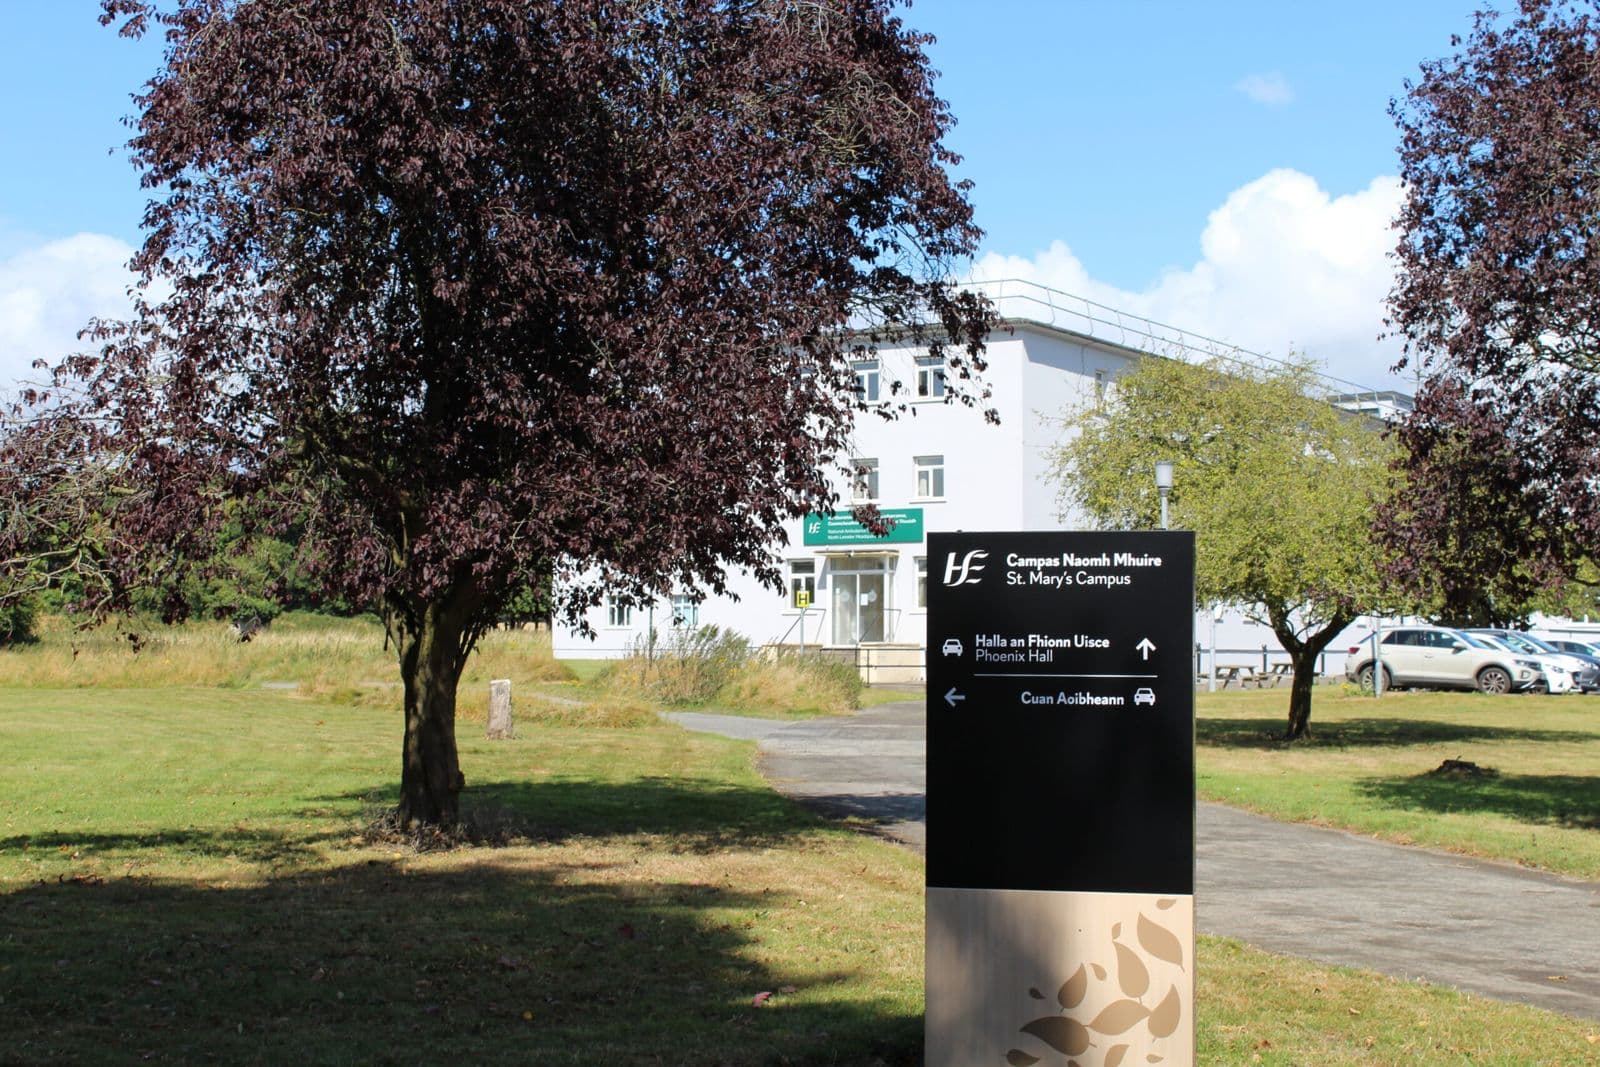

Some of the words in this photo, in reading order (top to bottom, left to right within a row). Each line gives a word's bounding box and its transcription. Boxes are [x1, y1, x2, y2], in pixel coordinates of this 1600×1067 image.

[1007, 553, 1060, 571] Campas
[1063, 553, 1110, 567] Naomh
[1114, 553, 1162, 566] Mhuire
[1007, 571, 1026, 585] St.
[1030, 571, 1072, 589] Mary's
[1076, 571, 1131, 589] Campus
[976, 634, 1007, 648] Halla
[1010, 639, 1025, 648] an
[1028, 634, 1071, 648] Fhionn
[1074, 635, 1110, 648] Uisce
[976, 650, 1025, 661] Phoenix
[1029, 650, 1053, 662] Hall
[1022, 692, 1053, 704] Cuan
[1057, 692, 1124, 705] Aoibheann
